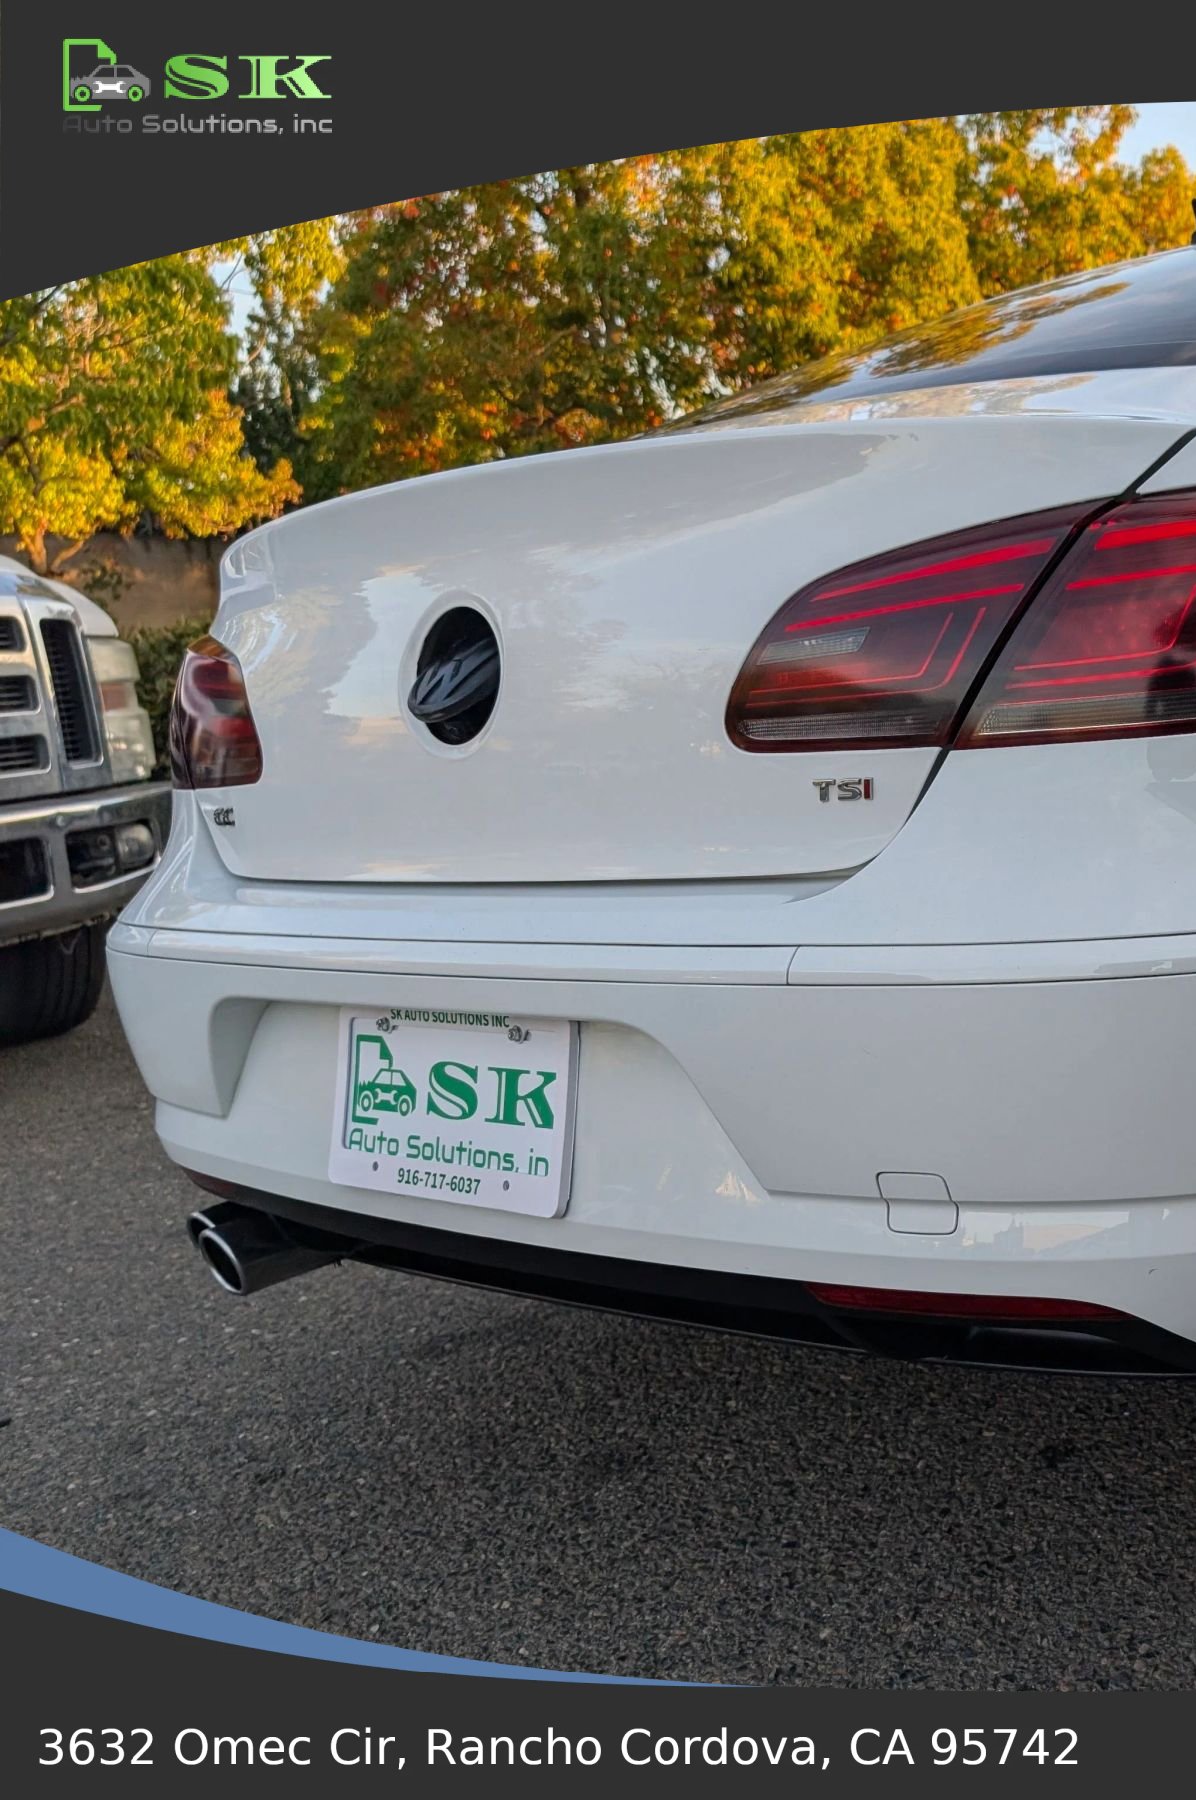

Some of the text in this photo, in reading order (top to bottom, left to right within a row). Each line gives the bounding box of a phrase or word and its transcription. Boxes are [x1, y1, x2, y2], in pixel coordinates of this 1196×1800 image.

[812, 777, 874, 802] TSI
[390, 1008, 510, 1028] SK AUTO SOLUTIONS INC
[426, 1060, 557, 1129] SK
[349, 1127, 400, 1156] Auto
[406, 1134, 519, 1173] Solutions,
[397, 1167, 481, 1195] 916-717-6037
